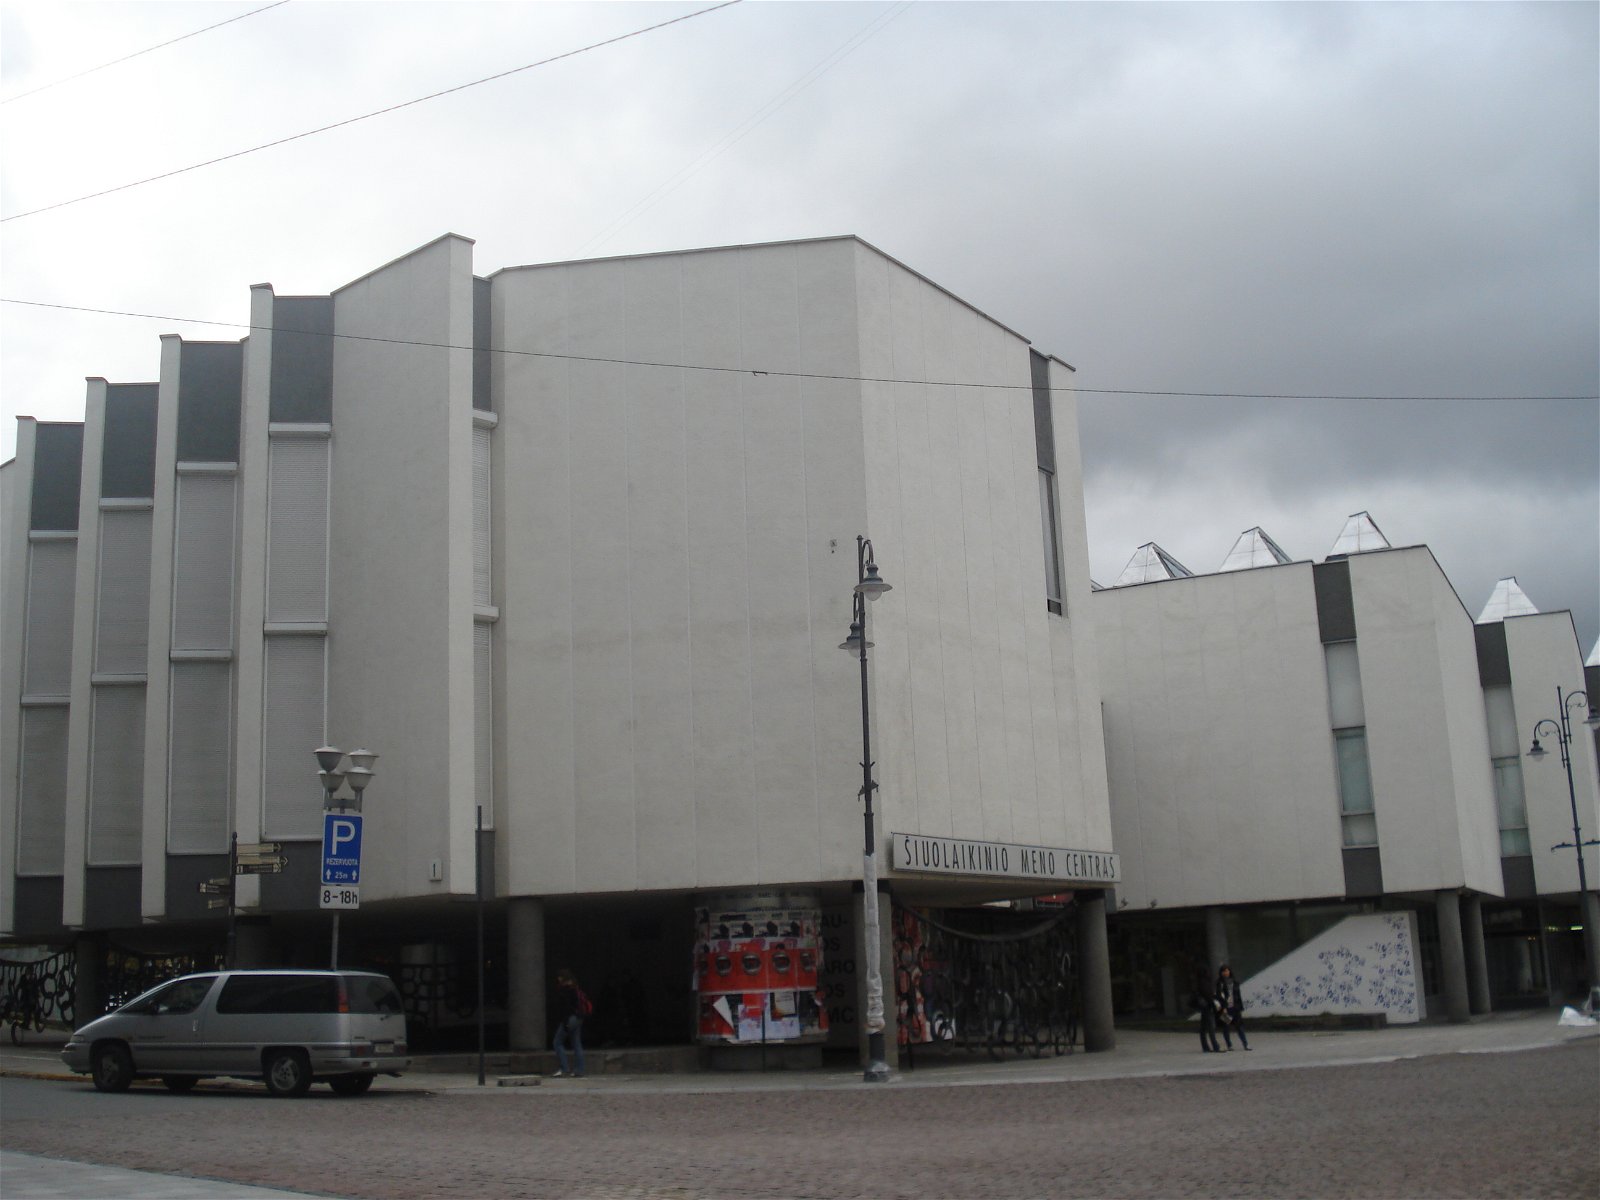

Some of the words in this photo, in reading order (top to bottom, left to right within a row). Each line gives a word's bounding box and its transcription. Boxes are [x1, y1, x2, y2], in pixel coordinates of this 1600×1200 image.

[331, 820, 356, 855] P
[326, 857, 358, 866] REZERVUOTA
[904, 835, 1009, 872] ŠIUOLAIKINIO
[1021, 849, 1055, 875] MENO
[1066, 853, 1115, 879] CENTRAS
[323, 890, 358, 904] 8-18h
